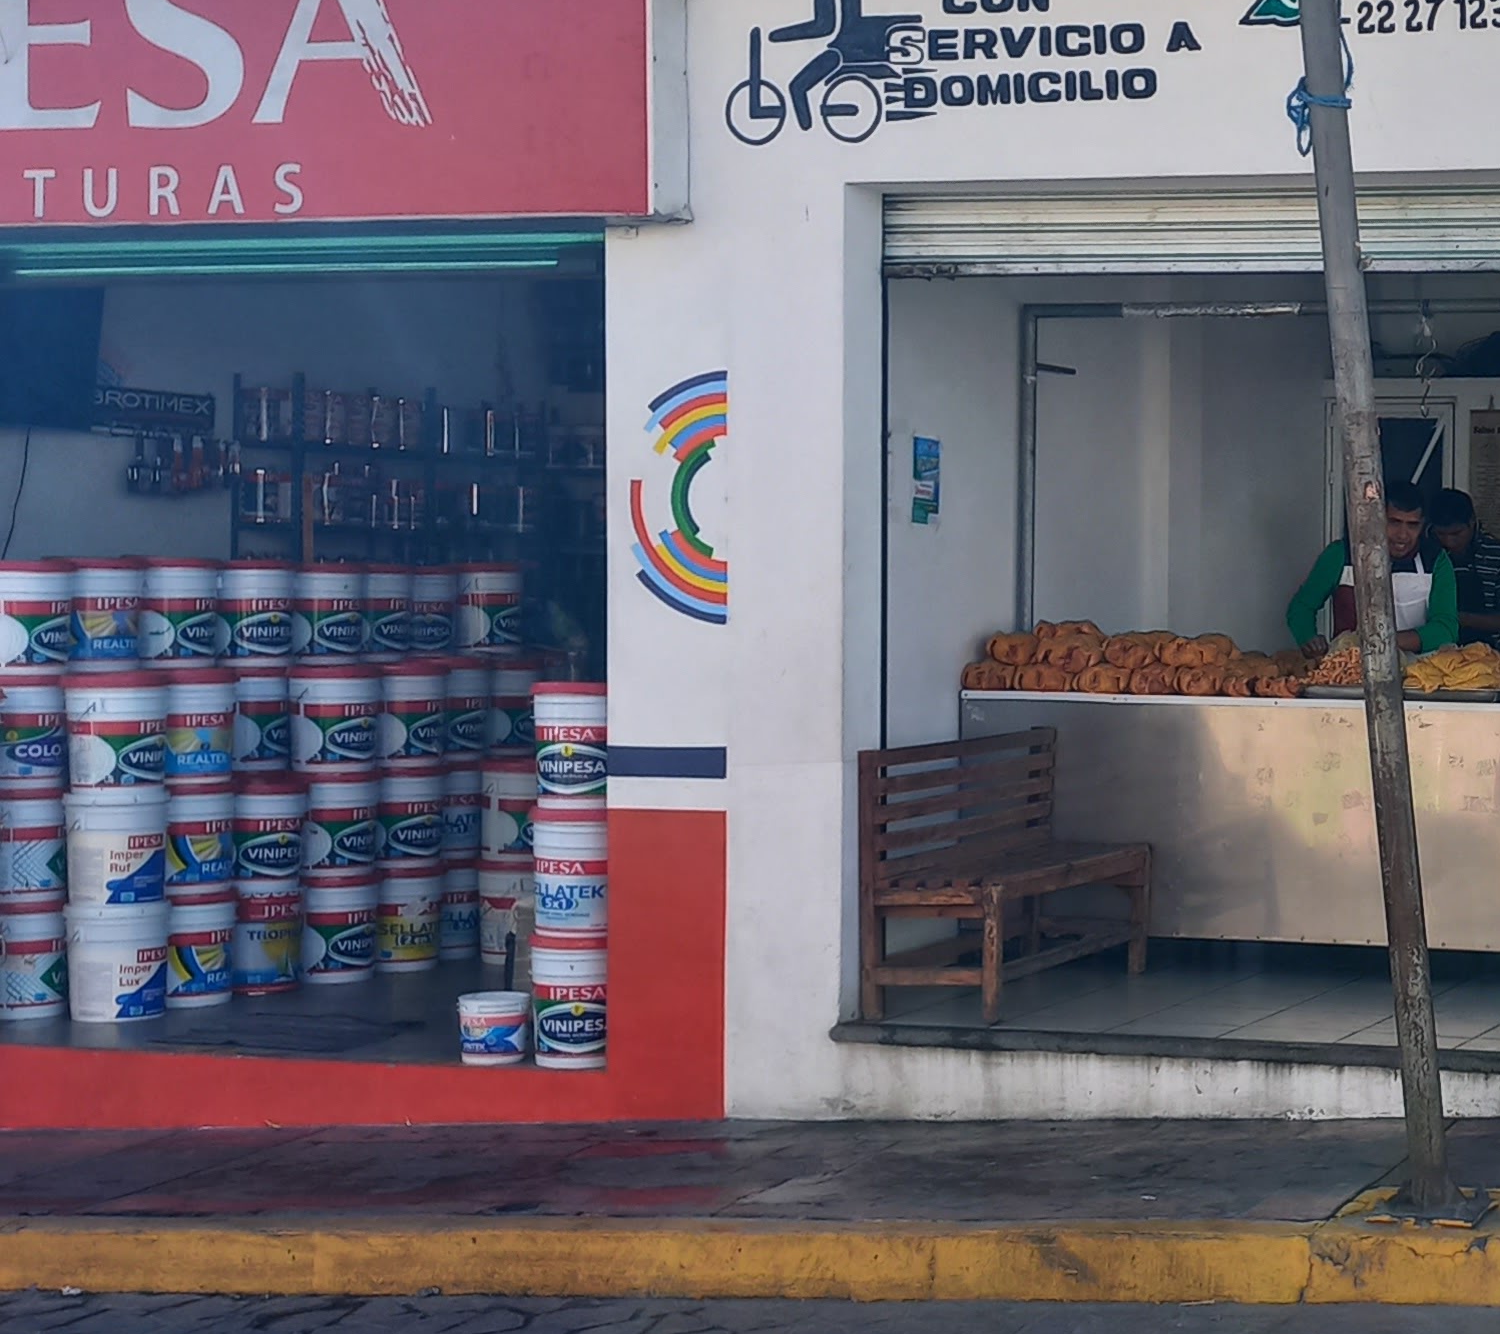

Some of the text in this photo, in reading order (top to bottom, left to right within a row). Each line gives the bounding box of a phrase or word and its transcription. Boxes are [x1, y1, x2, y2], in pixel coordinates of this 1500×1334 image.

[886, 21, 1201, 64] SERVICIO A
[903, 68, 1157, 109] DOMICILIO
[23, 163, 303, 218] TURAS
[540, 760, 606, 774] VINIPESA
